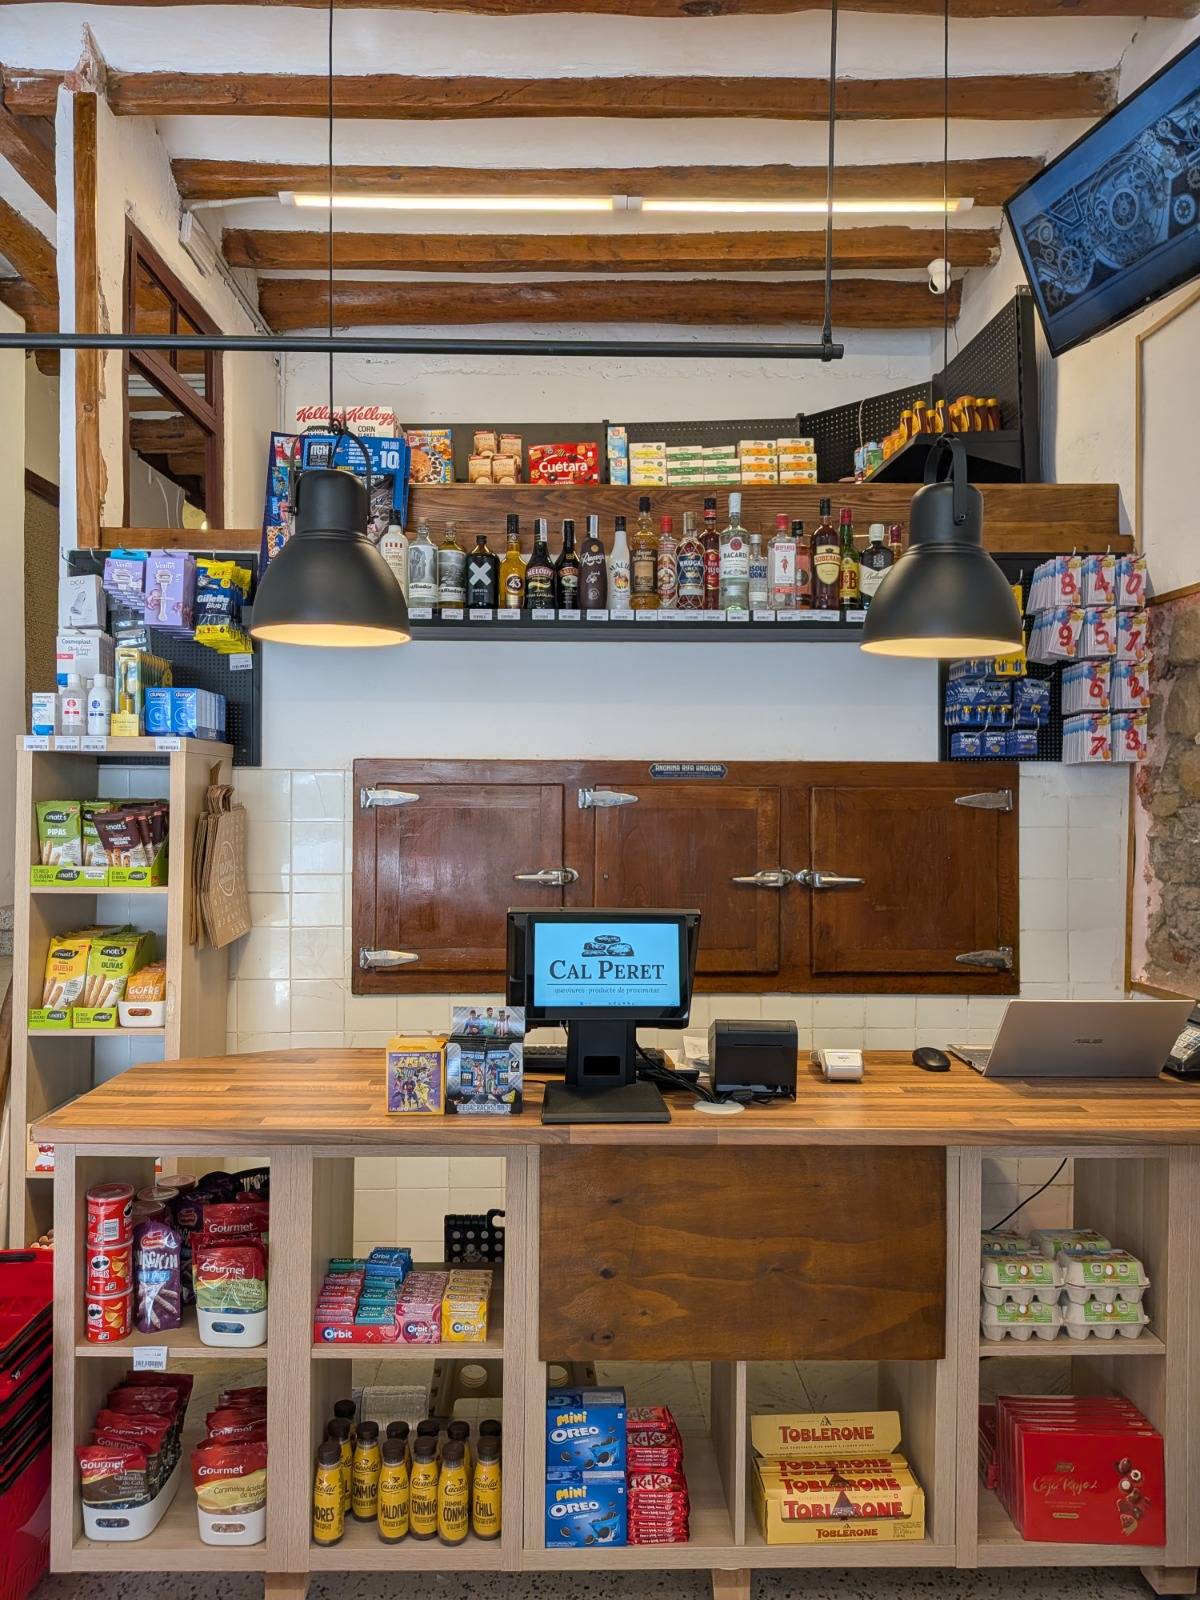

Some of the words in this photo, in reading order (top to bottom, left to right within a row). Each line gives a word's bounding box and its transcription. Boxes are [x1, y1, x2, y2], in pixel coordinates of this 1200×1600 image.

[358, 425, 376, 433] CORN
[539, 461, 588, 473] Cuétara
[508, 580, 521, 588] 43
[1061, 572, 1076, 595] 8
[1095, 571, 1110, 592] 4
[1126, 573, 1142, 594] 0
[197, 594, 230, 604] Gillette
[206, 602, 221, 611] Blue
[1059, 625, 1072, 646] 9
[1094, 623, 1109, 645] 5
[1125, 631, 1141, 652] 1
[1023, 687, 1049, 696] VARTA
[1090, 678, 1105, 698] 6
[1127, 676, 1144, 698] 2
[1090, 736, 1107, 756] 7
[1125, 729, 1140, 751] 3
[47, 828, 68, 836] PIPAS
[101, 961, 124, 970] OLIVAS
[128, 985, 160, 995] GOFRE
[209, 1222, 254, 1233] Gourmet
[201, 1261, 245, 1275] Gourmet
[324, 1329, 353, 1339] Orbit
[407, 1325, 428, 1333] Orbit
[551, 1426, 599, 1442] OREO
[633, 1432, 666, 1446] KitKat
[779, 1426, 875, 1444] TOBLERONE
[80, 1459, 124, 1470] Gourmet
[198, 1465, 244, 1476] Gourmet
[778, 1459, 892, 1471] TOBLERONE
[636, 1474, 671, 1490] KitKat
[475, 1502, 494, 1517] CHILL
[551, 1501, 599, 1517] OREO
[815, 1528, 878, 1539] TOBLERONE
